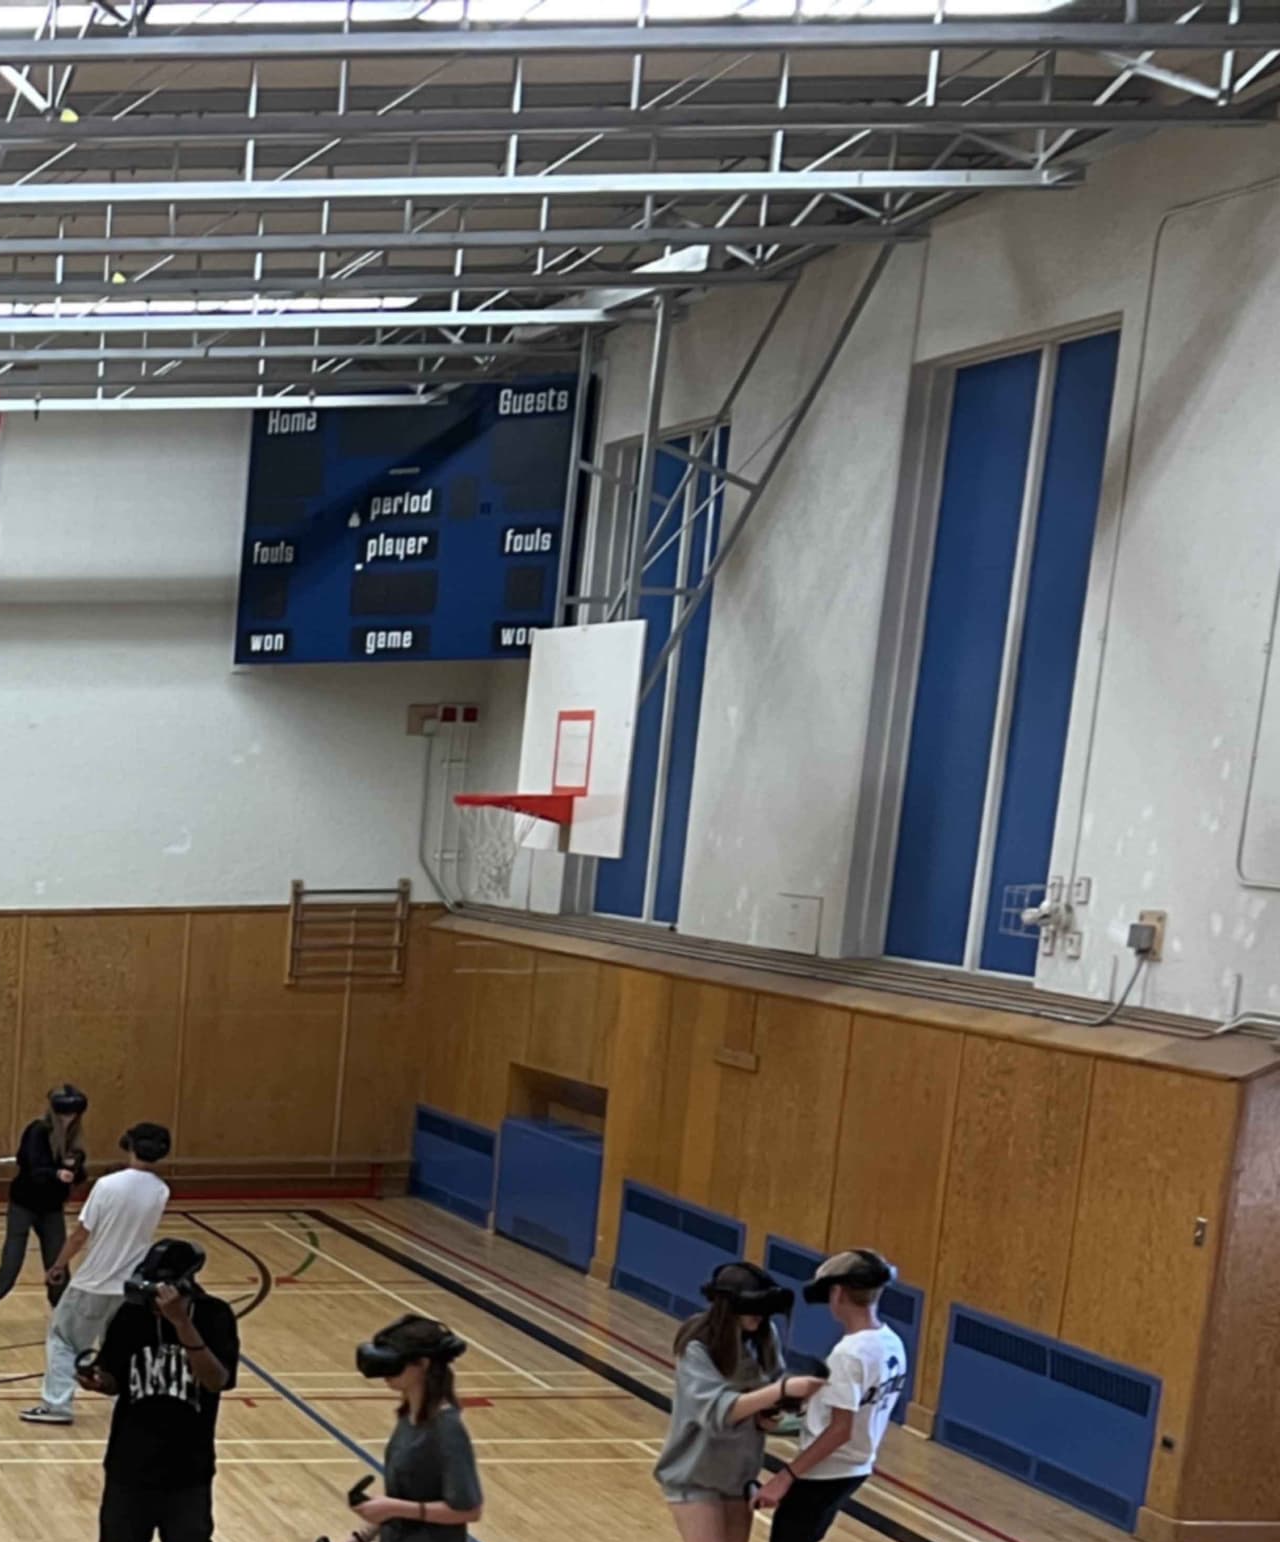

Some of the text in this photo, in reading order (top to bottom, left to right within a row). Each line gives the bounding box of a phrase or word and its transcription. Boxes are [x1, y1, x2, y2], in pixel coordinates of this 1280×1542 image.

[499, 387, 568, 415] Guests
[370, 489, 433, 520] period
[253, 541, 294, 564] fouls
[366, 533, 428, 561] player
[504, 528, 552, 553] fouls
[250, 633, 284, 652] won
[365, 630, 413, 654] game
